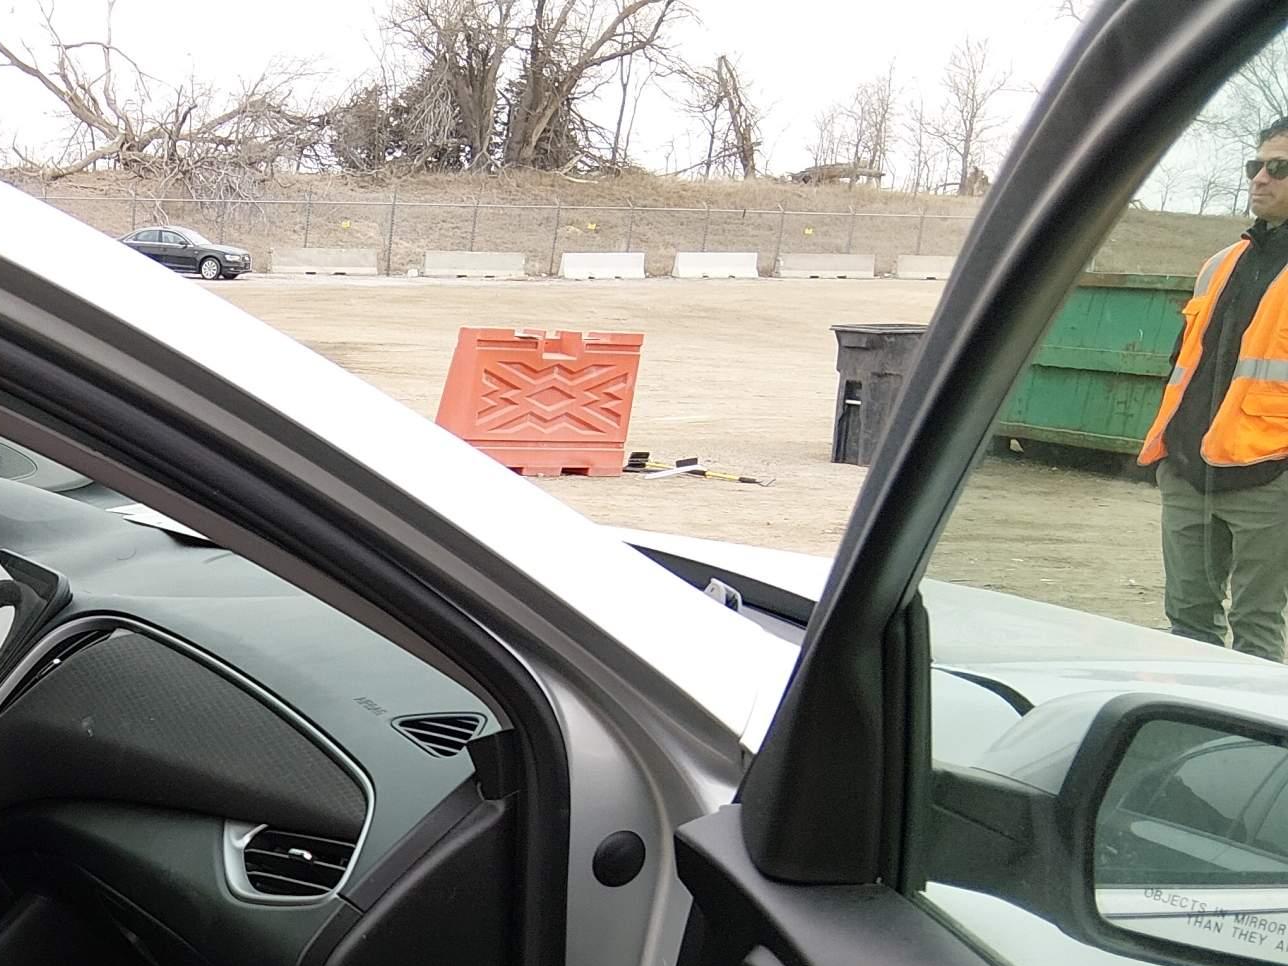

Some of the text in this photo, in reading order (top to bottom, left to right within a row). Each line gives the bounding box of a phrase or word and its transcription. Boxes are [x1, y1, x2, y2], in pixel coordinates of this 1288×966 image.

[1144, 887, 1208, 914] OBJECTS
[1233, 912, 1287, 936] MIRROR
[1186, 914, 1288, 953] THAN THEY A
